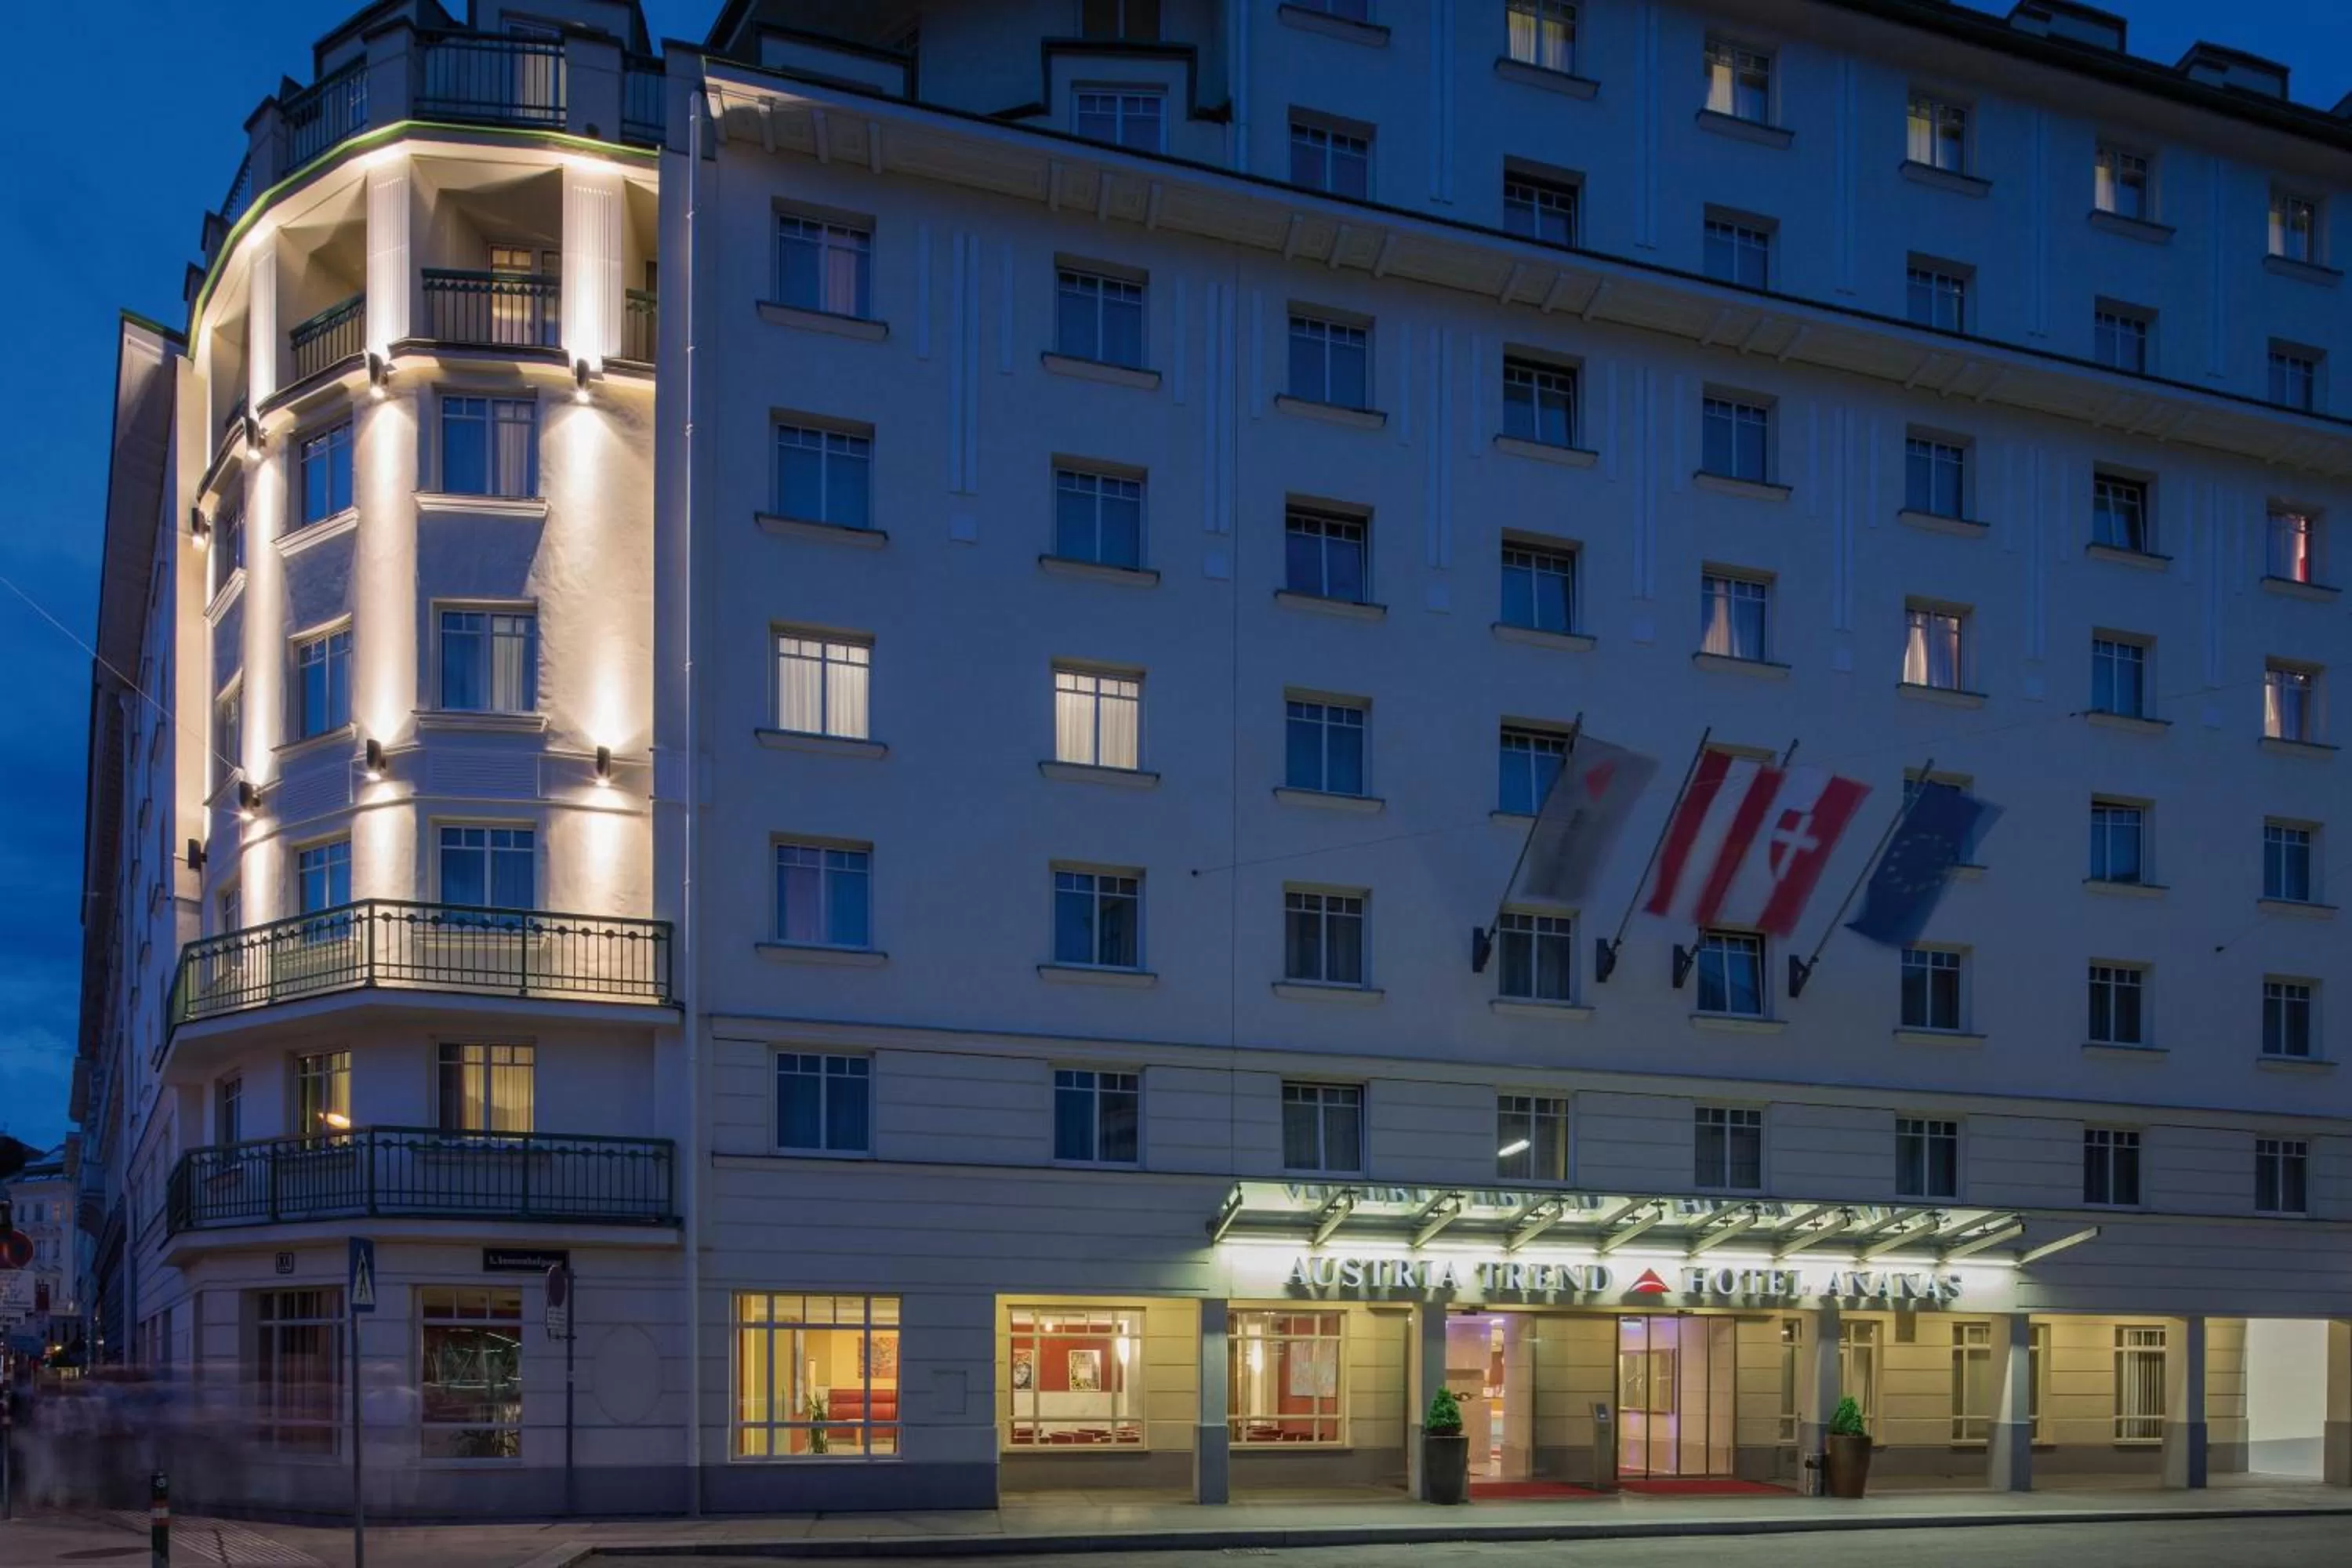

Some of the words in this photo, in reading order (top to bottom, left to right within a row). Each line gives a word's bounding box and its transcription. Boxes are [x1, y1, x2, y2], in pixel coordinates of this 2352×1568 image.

[1285, 1256, 1462, 1290] AUSTRIA
[1475, 1261, 1613, 1293] TREND
[1680, 1267, 1811, 1296] HOTEL
[1820, 1270, 1963, 1300] ANANAS
